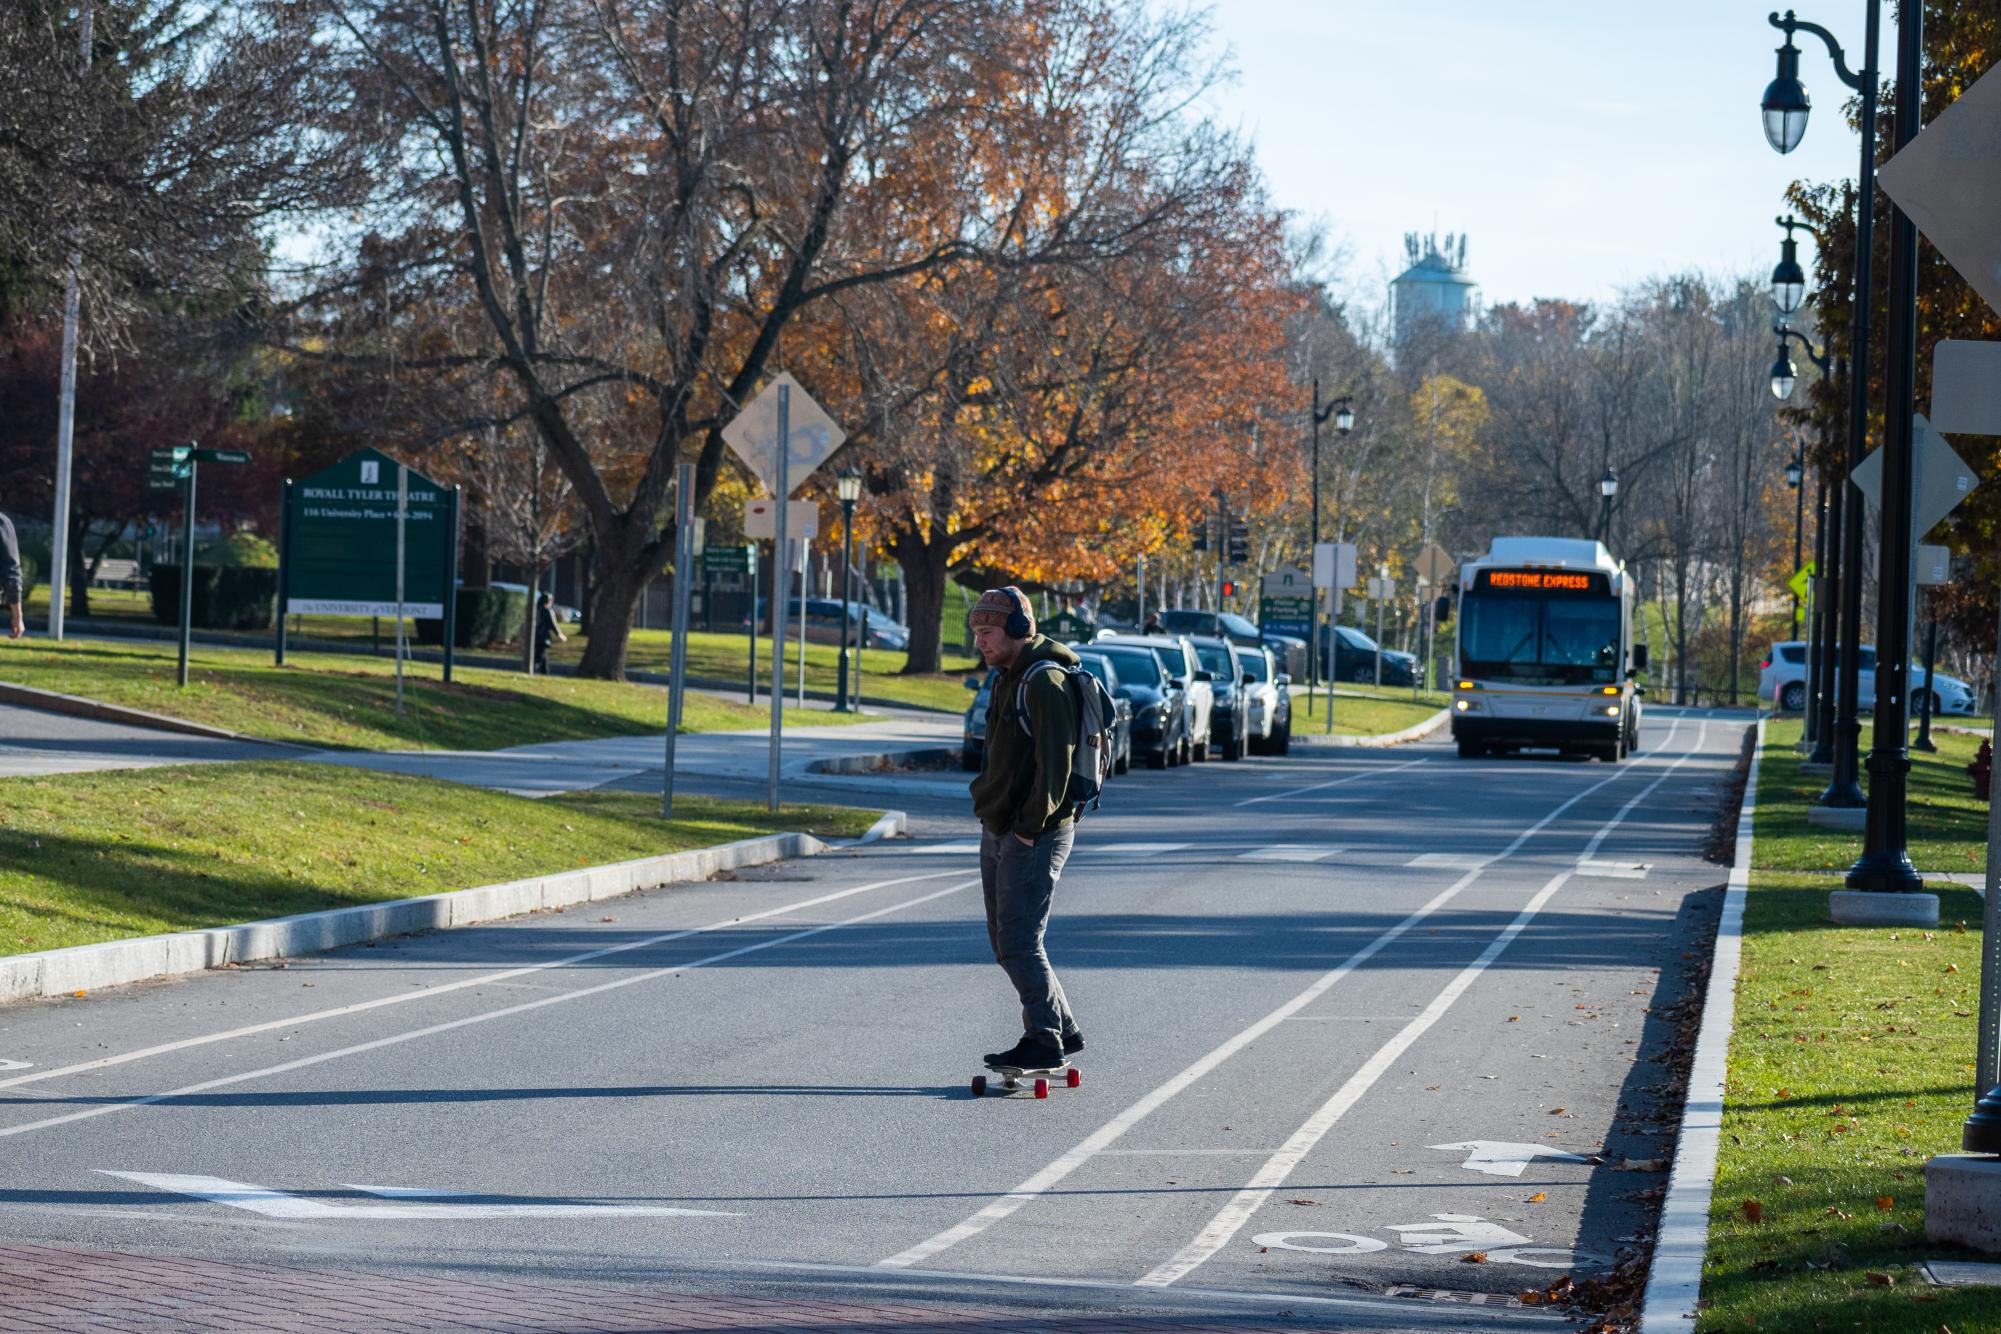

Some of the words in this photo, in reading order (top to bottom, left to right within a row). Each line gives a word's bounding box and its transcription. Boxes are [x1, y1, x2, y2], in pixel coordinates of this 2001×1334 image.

[303, 488, 345, 500] ROYALL
[347, 489, 383, 500] TYLER
[384, 490, 436, 502] THATRE
[320, 508, 362, 519] University
[1490, 571, 1540, 587] REDSTONE
[1543, 574, 1589, 589] EXPRESS
[315, 602, 369, 613] UNIVERSITY
